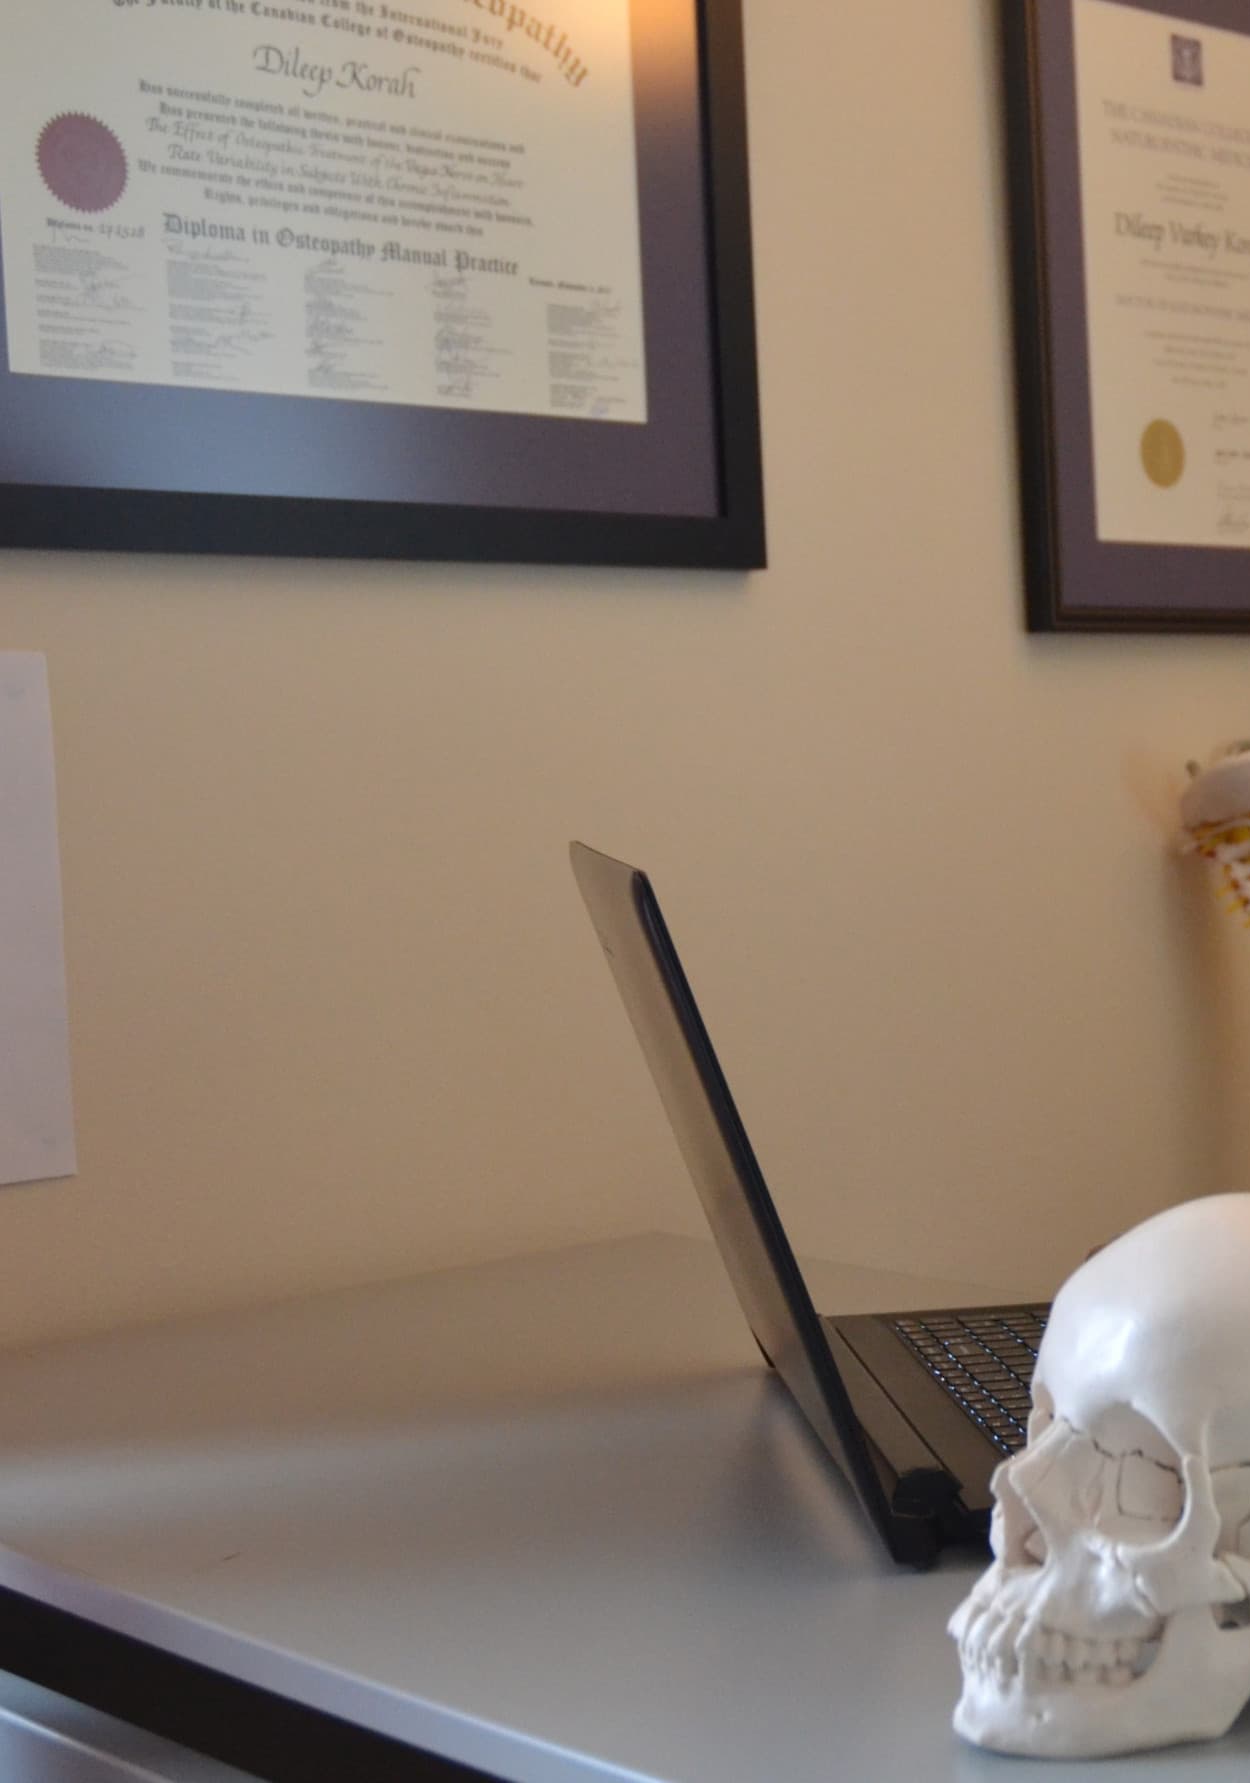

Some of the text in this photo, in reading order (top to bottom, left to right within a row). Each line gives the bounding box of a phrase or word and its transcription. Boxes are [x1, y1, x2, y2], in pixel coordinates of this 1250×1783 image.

[251, 1, 316, 25] Canadian
[320, 13, 371, 37] College
[375, 26, 389, 41] of
[393, 29, 466, 59] Osteopathy
[380, 4, 468, 38] International
[252, 44, 422, 99] Dileep Korah
[161, 211, 519, 276] Diploma in Osteopathy Manual Practice
